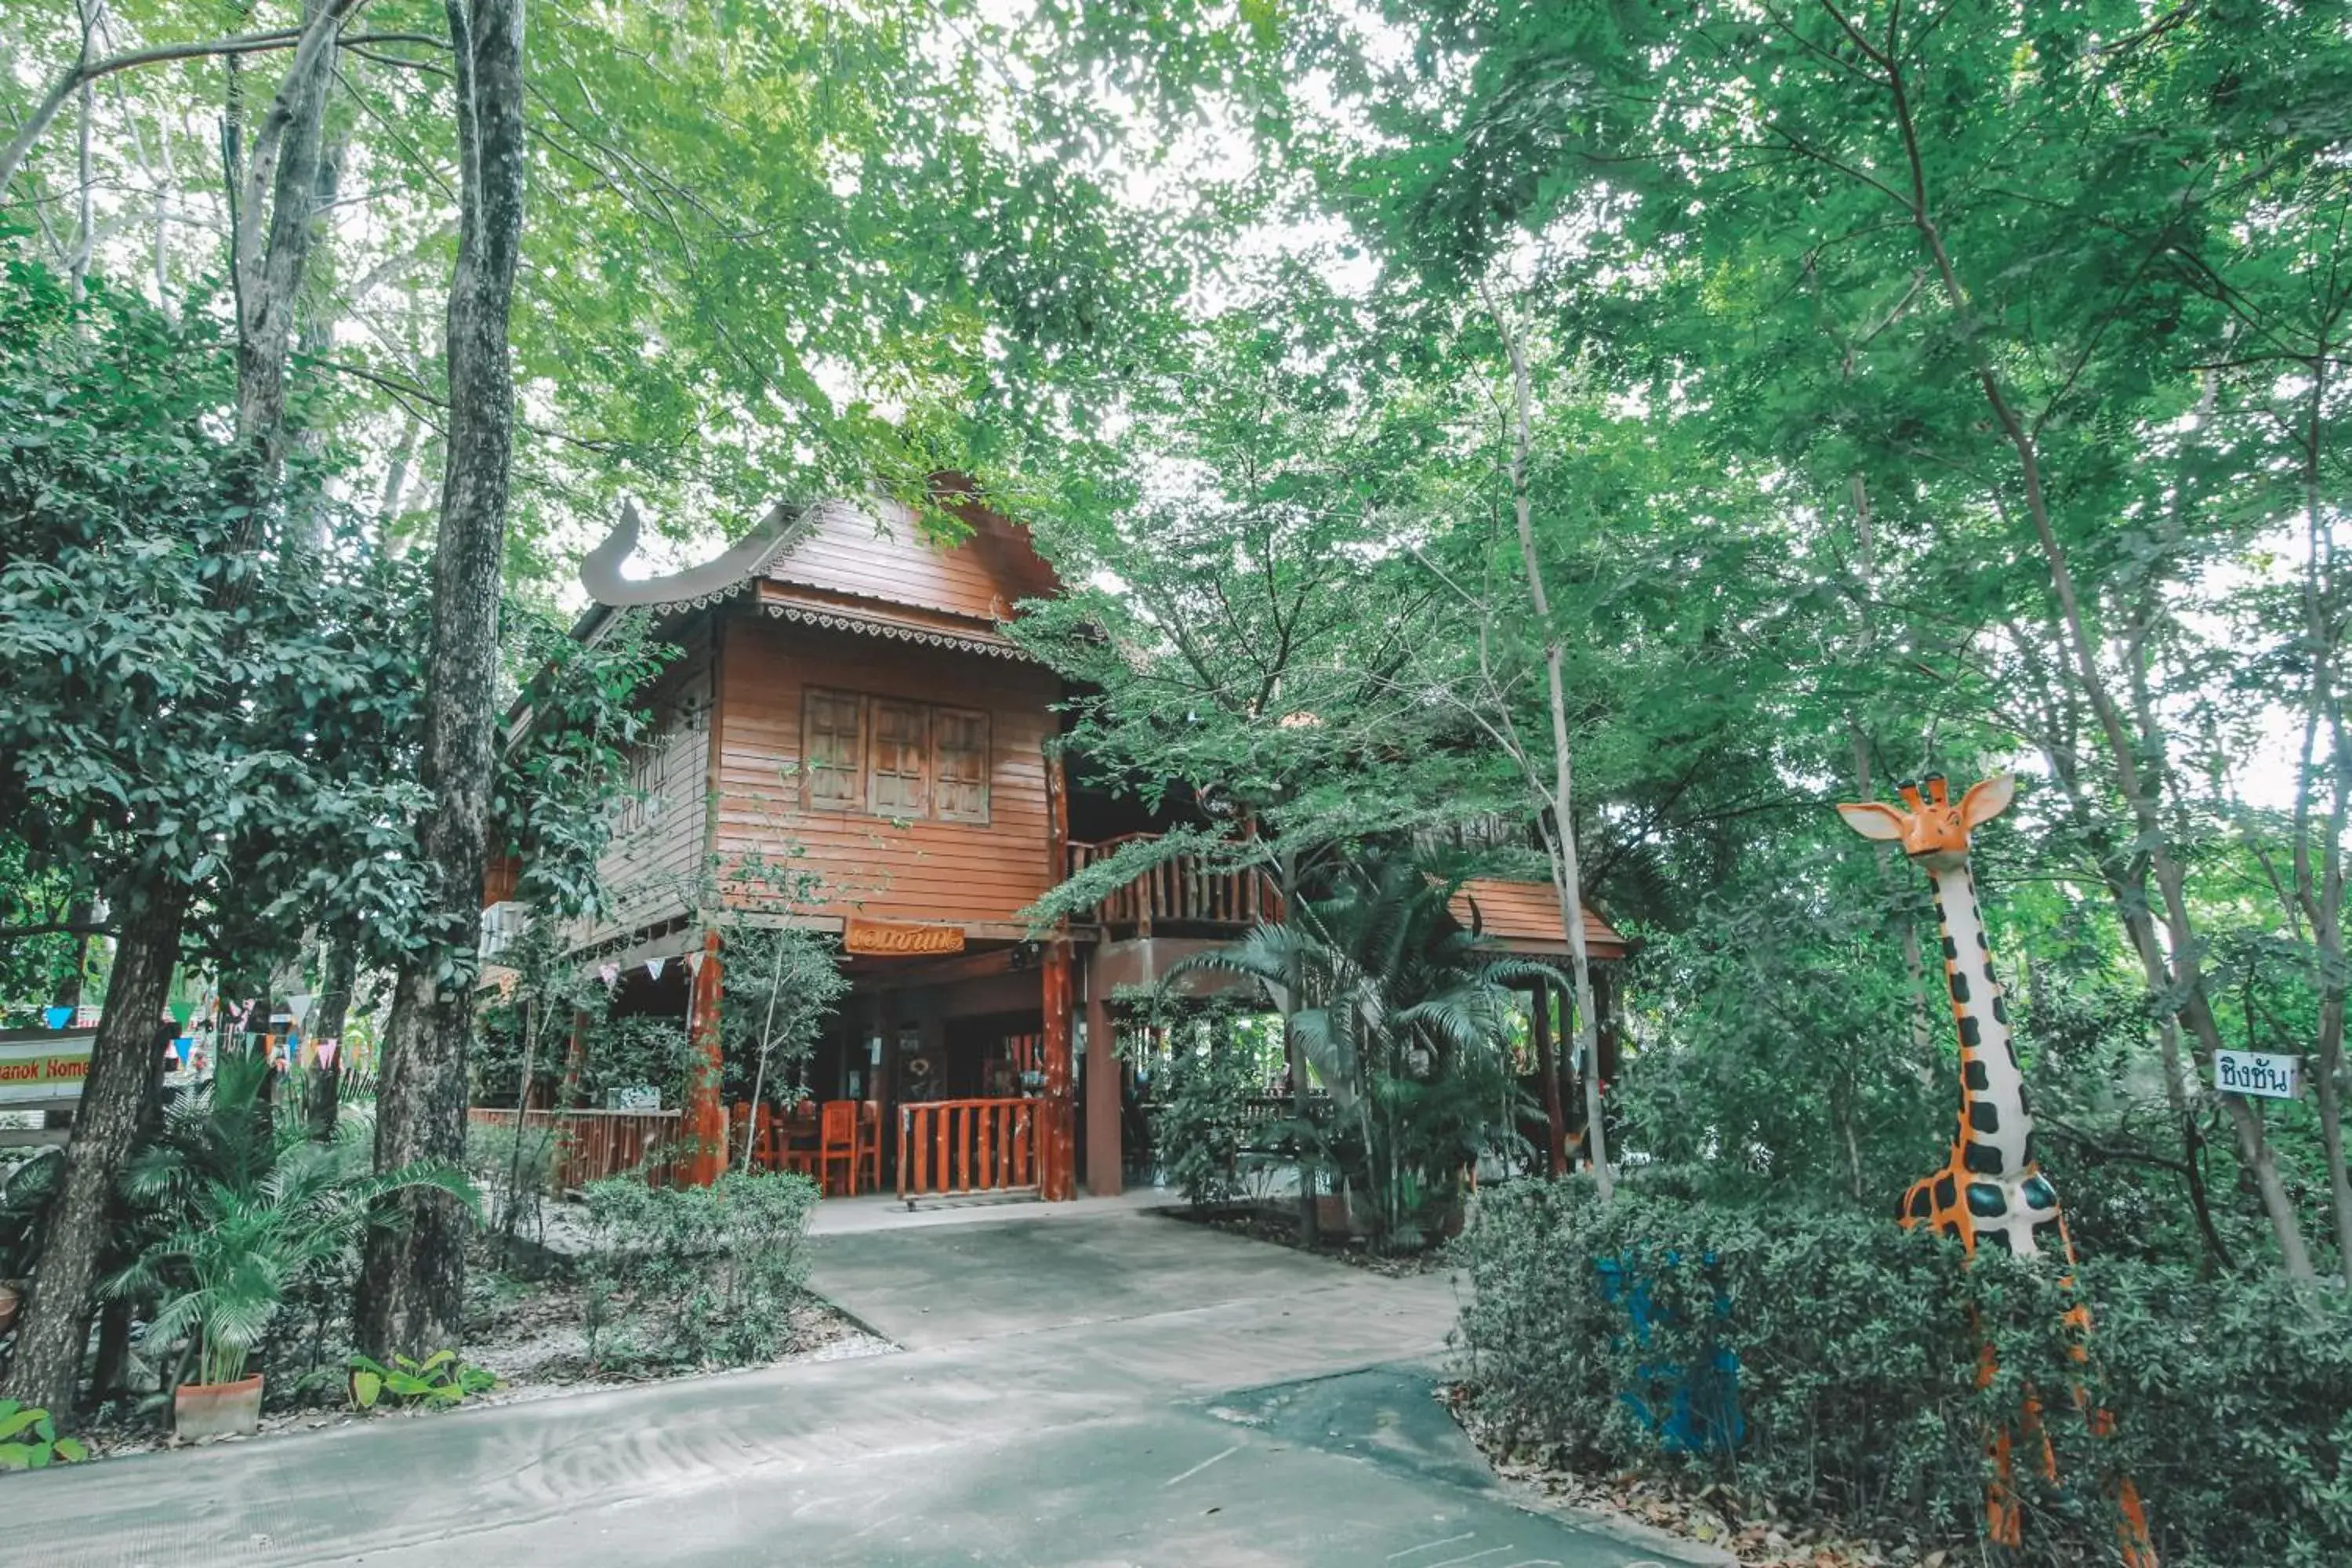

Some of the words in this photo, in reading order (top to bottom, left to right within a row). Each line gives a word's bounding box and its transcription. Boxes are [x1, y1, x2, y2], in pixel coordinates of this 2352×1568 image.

[0, 1060, 39, 1080] anok
[2220, 1056, 2287, 1092] ชิงชัน
